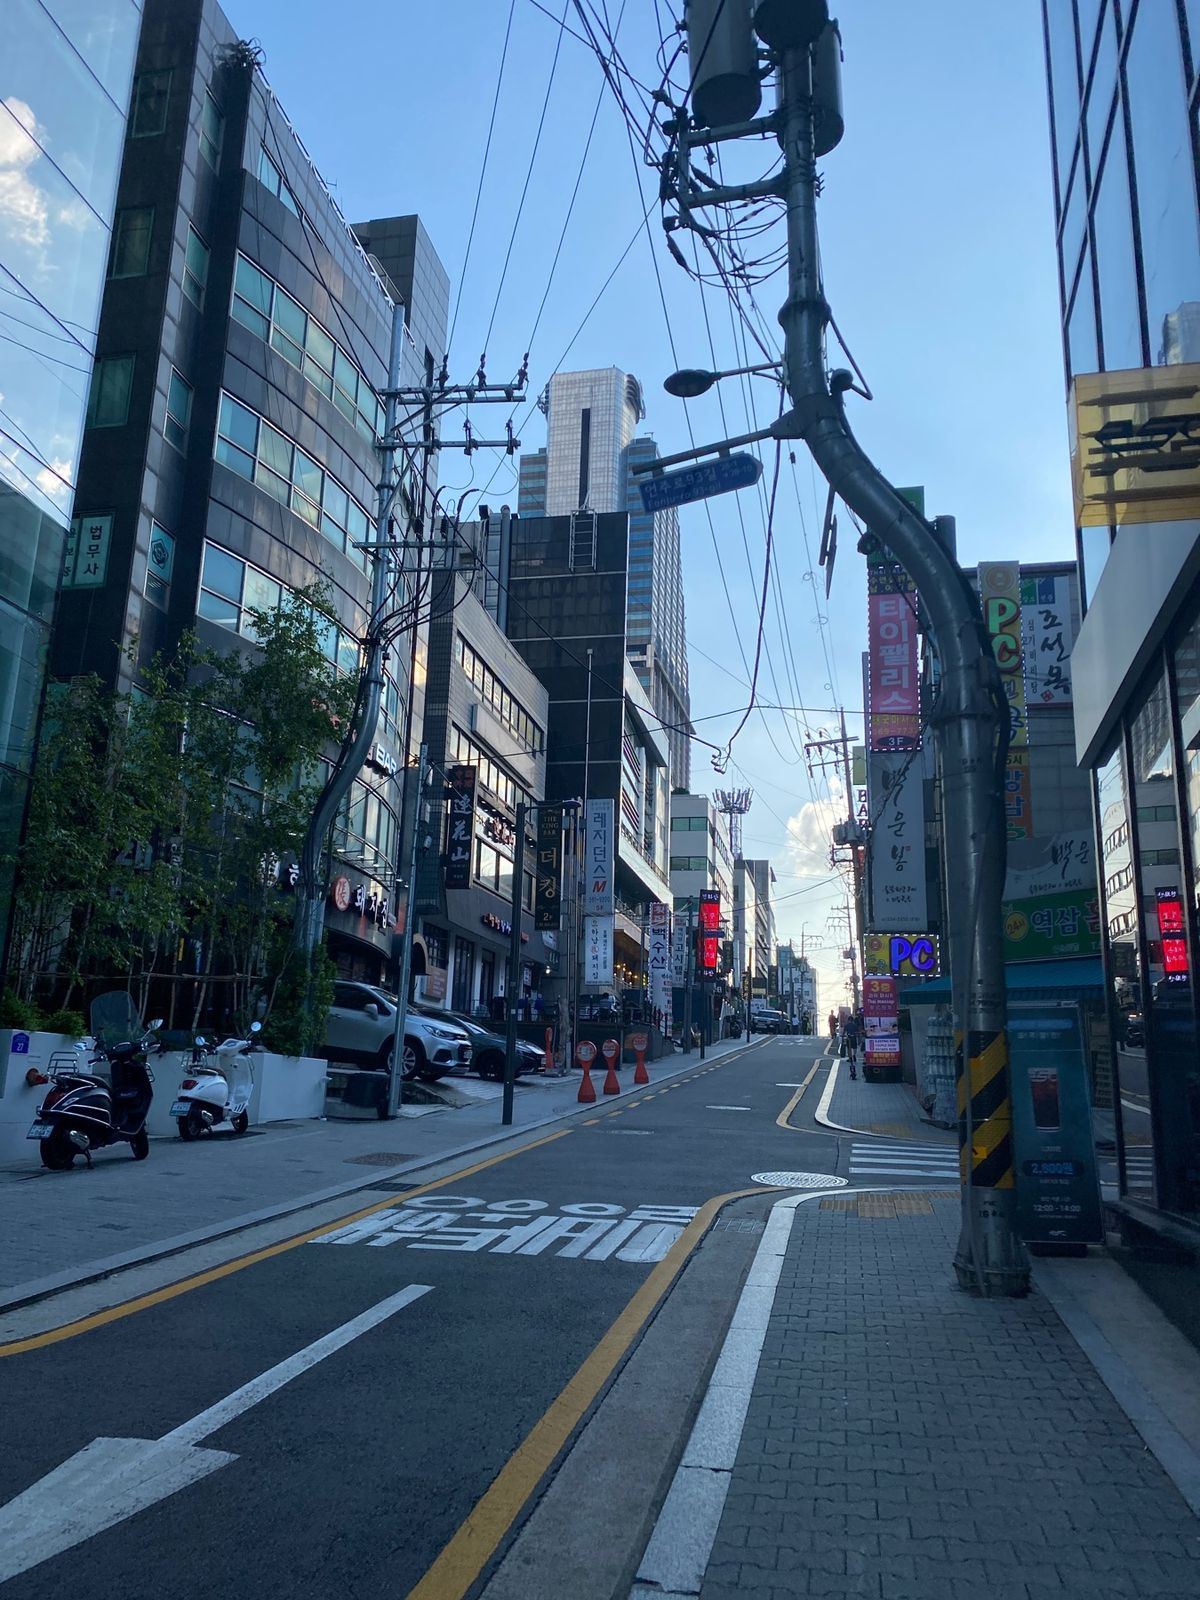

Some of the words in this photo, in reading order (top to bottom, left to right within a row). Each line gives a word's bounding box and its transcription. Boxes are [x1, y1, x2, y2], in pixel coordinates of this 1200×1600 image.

[84, 525, 102, 576] 법무사
[879, 595, 912, 711] 타이팰리스
[984, 597, 1021, 673] PC
[889, 737, 904, 746] 3F
[592, 812, 607, 878] 레지던스
[354, 884, 390, 929] 돼지집
[1031, 905, 1081, 938] 역삼
[650, 928, 667, 969] 백수산
[889, 936, 936, 971] PC
